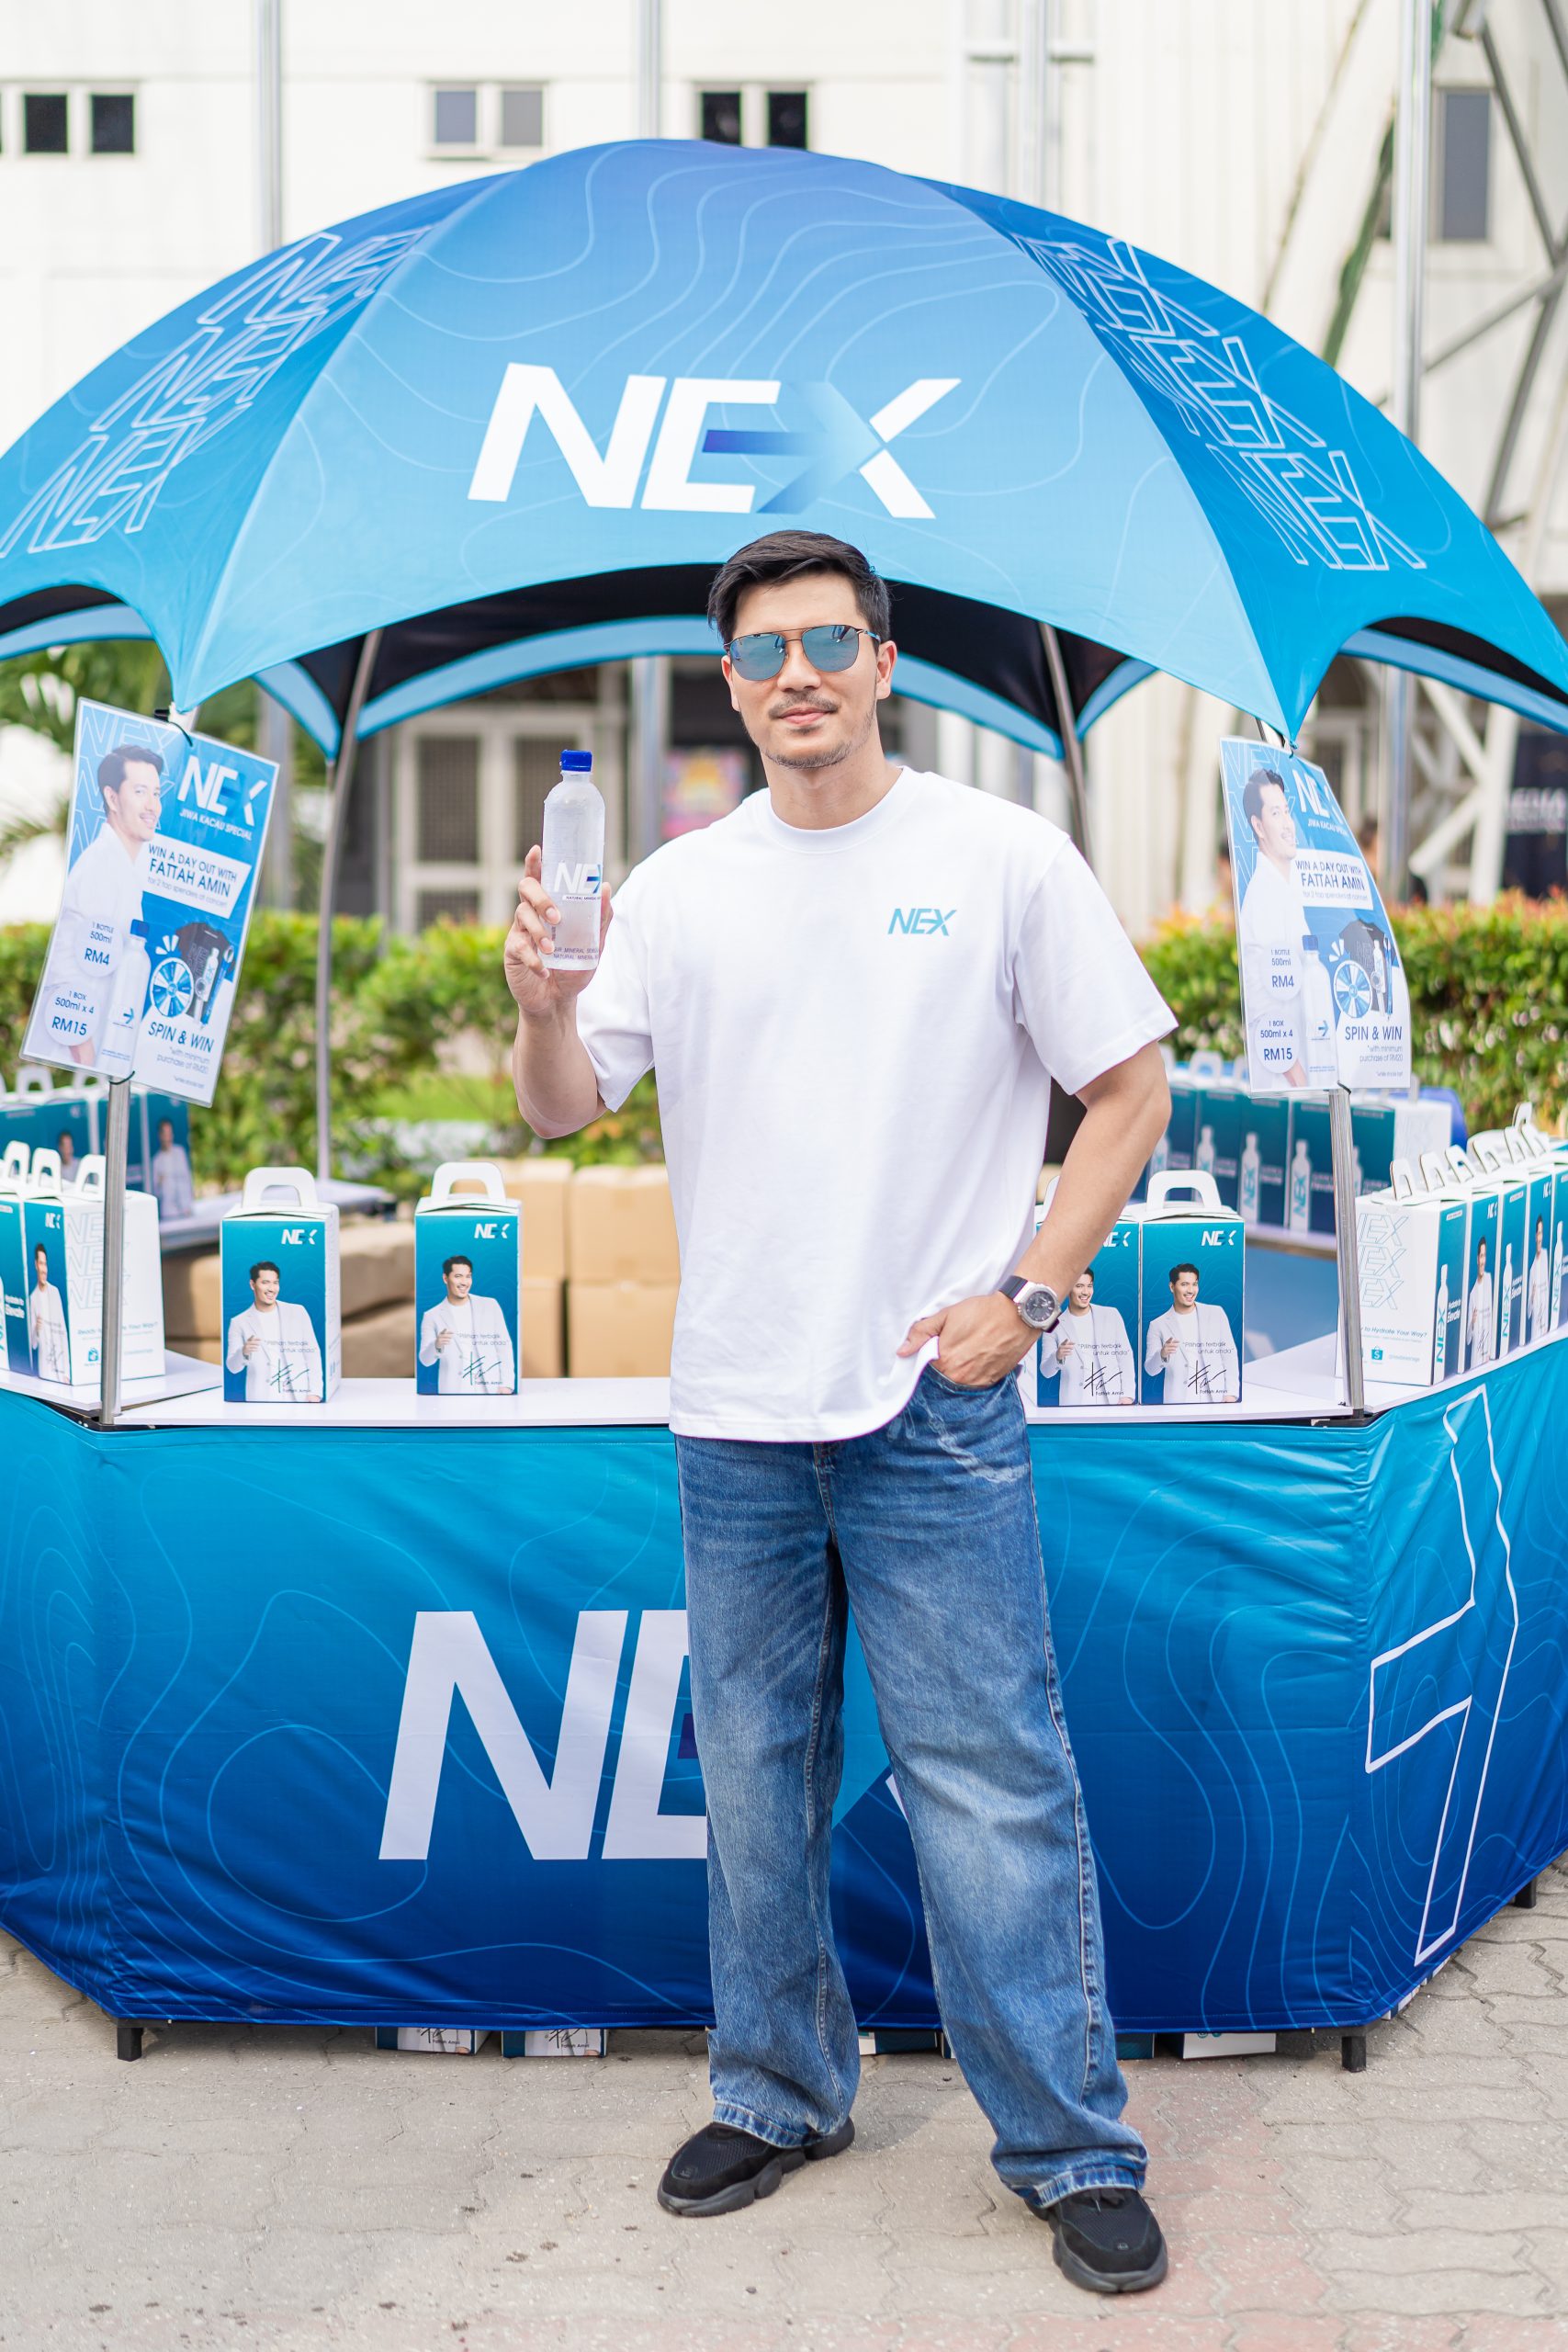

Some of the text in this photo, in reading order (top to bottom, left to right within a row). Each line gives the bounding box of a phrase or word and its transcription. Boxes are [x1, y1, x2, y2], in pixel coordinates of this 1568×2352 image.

[467, 362, 962, 519] NEX
[1205, 442, 1427, 571] NEX
[177, 755, 268, 827] NEX
[179, 808, 198, 821] JIWA
[149, 843, 238, 882] WIN A DAY OUT WITH
[1295, 860, 1362, 875] WIN A DAY OUT WITH
[150, 858, 231, 898] FATTAH AMIN
[1301, 873, 1365, 890] FATTAH AMIN
[887, 908, 957, 936] NEX
[89, 932, 112, 944] 500ml
[84, 948, 110, 966] RM4
[1271, 958, 1292, 967] 500ml
[1271, 975, 1294, 988] RM4
[73, 991, 87, 1001] BOX
[55, 997, 81, 1011] 500ml
[88, 1006, 95, 1014] 4
[51, 1016, 87, 1036] RM15
[1260, 1030, 1282, 1038] 500ml
[1345, 1026, 1403, 1041] SPIN & WIN
[148, 1022, 177, 1042] SPIN
[177, 1030, 187, 1045] &
[190, 1033, 215, 1053] WIN
[1263, 1047, 1292, 1060] RM15
[281, 1228, 318, 1246] NEX
[474, 1223, 510, 1239] NEX
[1201, 1229, 1237, 1247] NEX
[1359, 1276, 1404, 1310] EX
[1371, 1327, 1395, 1335] Hydrate
[378, 1610, 709, 1860] NE
